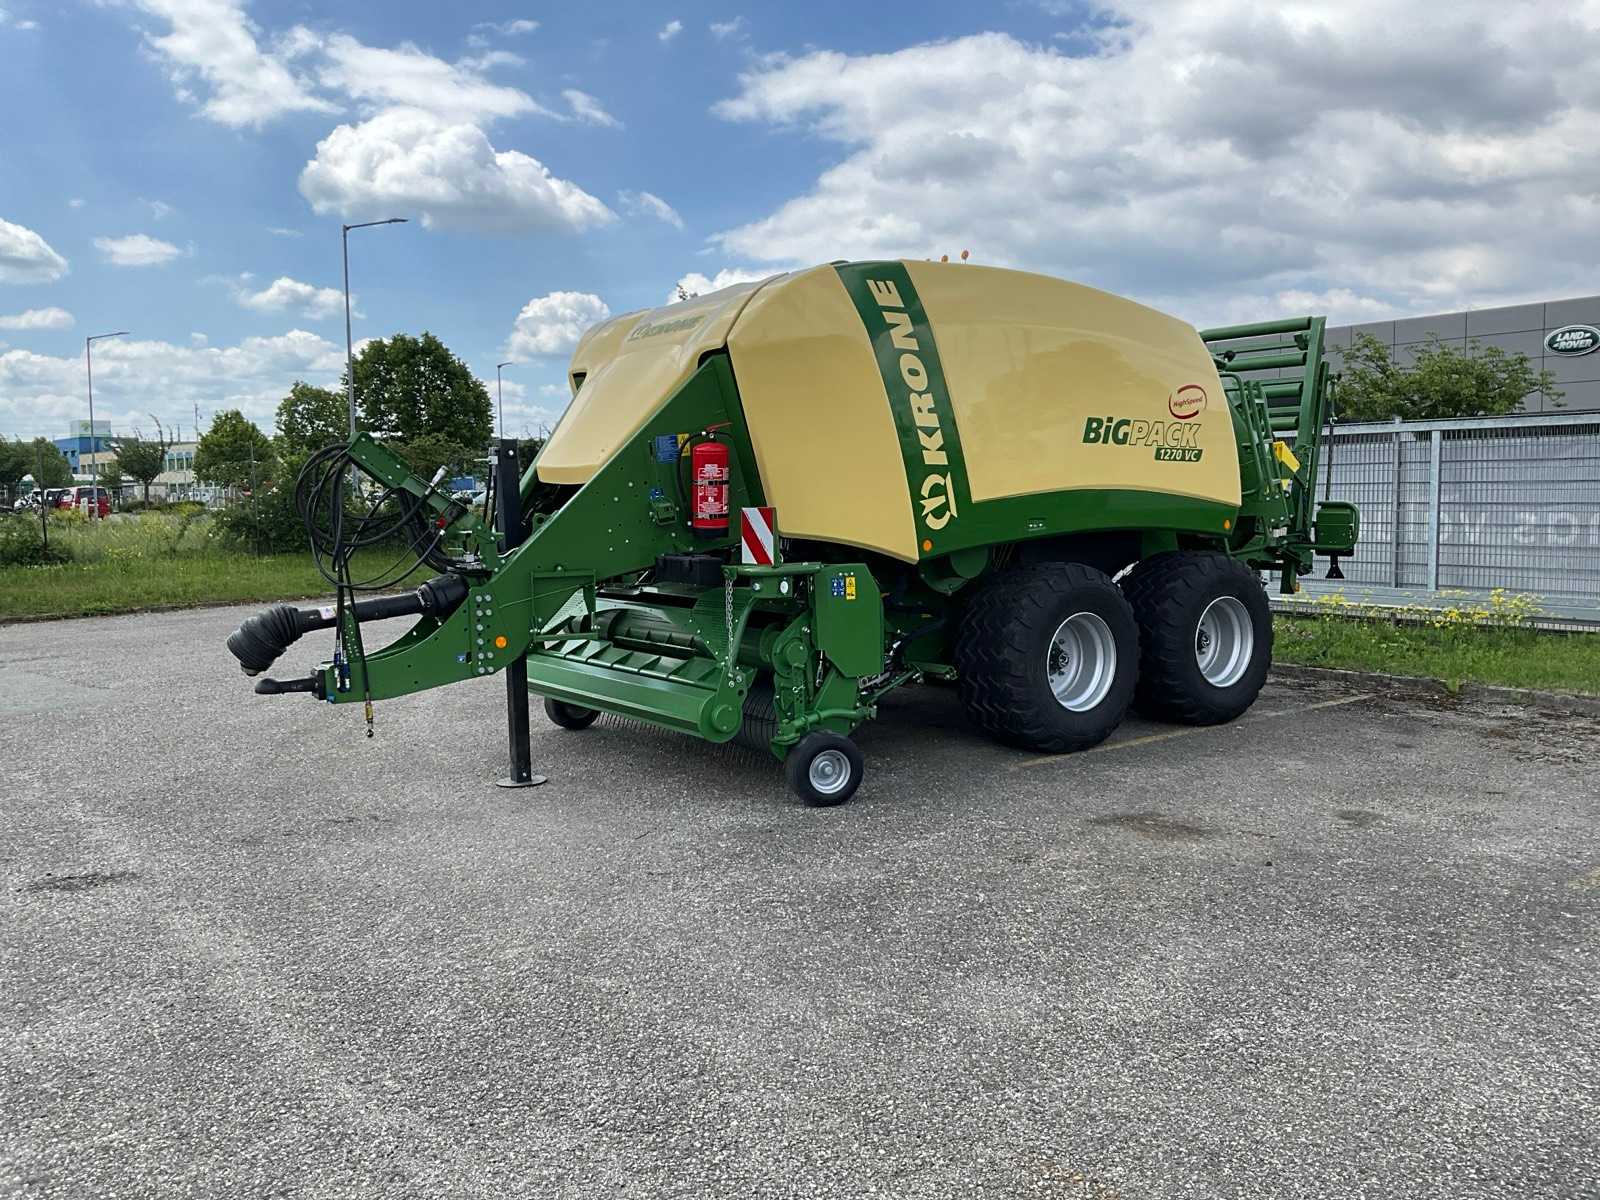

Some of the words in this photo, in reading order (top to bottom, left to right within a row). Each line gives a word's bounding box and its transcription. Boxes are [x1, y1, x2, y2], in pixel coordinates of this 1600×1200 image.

[1556, 331, 1584, 341] LAND
[1558, 340, 1592, 349] ROVER
[866, 279, 949, 465] KRONE
[1159, 448, 1182, 461] 1270
[1184, 449, 1199, 461] VC
